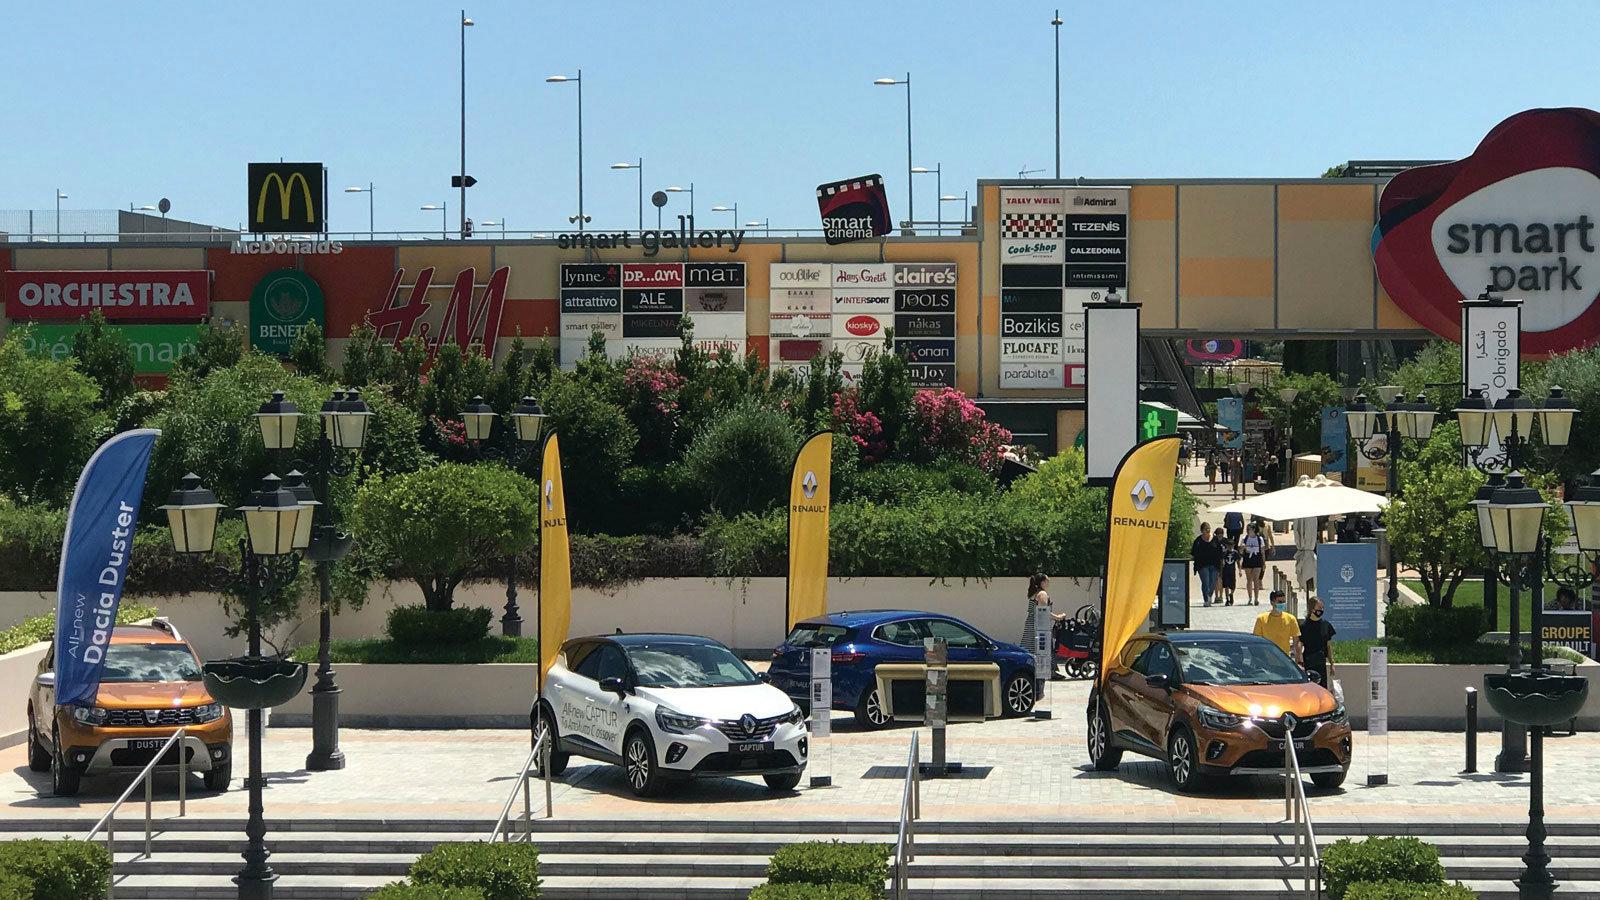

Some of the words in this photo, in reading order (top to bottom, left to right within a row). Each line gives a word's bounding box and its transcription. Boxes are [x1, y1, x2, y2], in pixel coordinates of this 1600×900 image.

[1084, 198, 1116, 206] Admiral
[822, 215, 873, 229] smart
[558, 230, 631, 249] smart
[641, 215, 745, 257] gallery
[828, 228, 873, 238] cinema
[1447, 215, 1594, 254] smart
[230, 240, 343, 254] McDonald's
[1008, 243, 1057, 255] Cook-Shop
[565, 268, 605, 286] lynne
[895, 267, 955, 284] claire's
[1490, 257, 1582, 291] park
[18, 283, 195, 306] ORCHESTRA
[565, 295, 618, 308] attrattivo
[843, 296, 890, 304] INTERSPORT
[901, 294, 949, 309] JOOLS
[591, 321, 616, 331] gallery
[847, 321, 879, 331] kiosky's
[1004, 318, 1060, 333] Bozikis
[1003, 342, 1058, 355] FLOCAFE
[1493, 321, 1510, 388] Obrigado
[792, 505, 827, 513] RENAULT
[1113, 517, 1168, 530] RENAULT
[83, 596, 113, 665] Dacia
[99, 500, 134, 585] Duster
[68, 593, 88, 659] All-new
[1541, 626, 1590, 639] GROUPE
[586, 704, 618, 728] CAPTUR
[136, 740, 169, 750] DUSTE
[739, 744, 765, 752] CAPTUR
